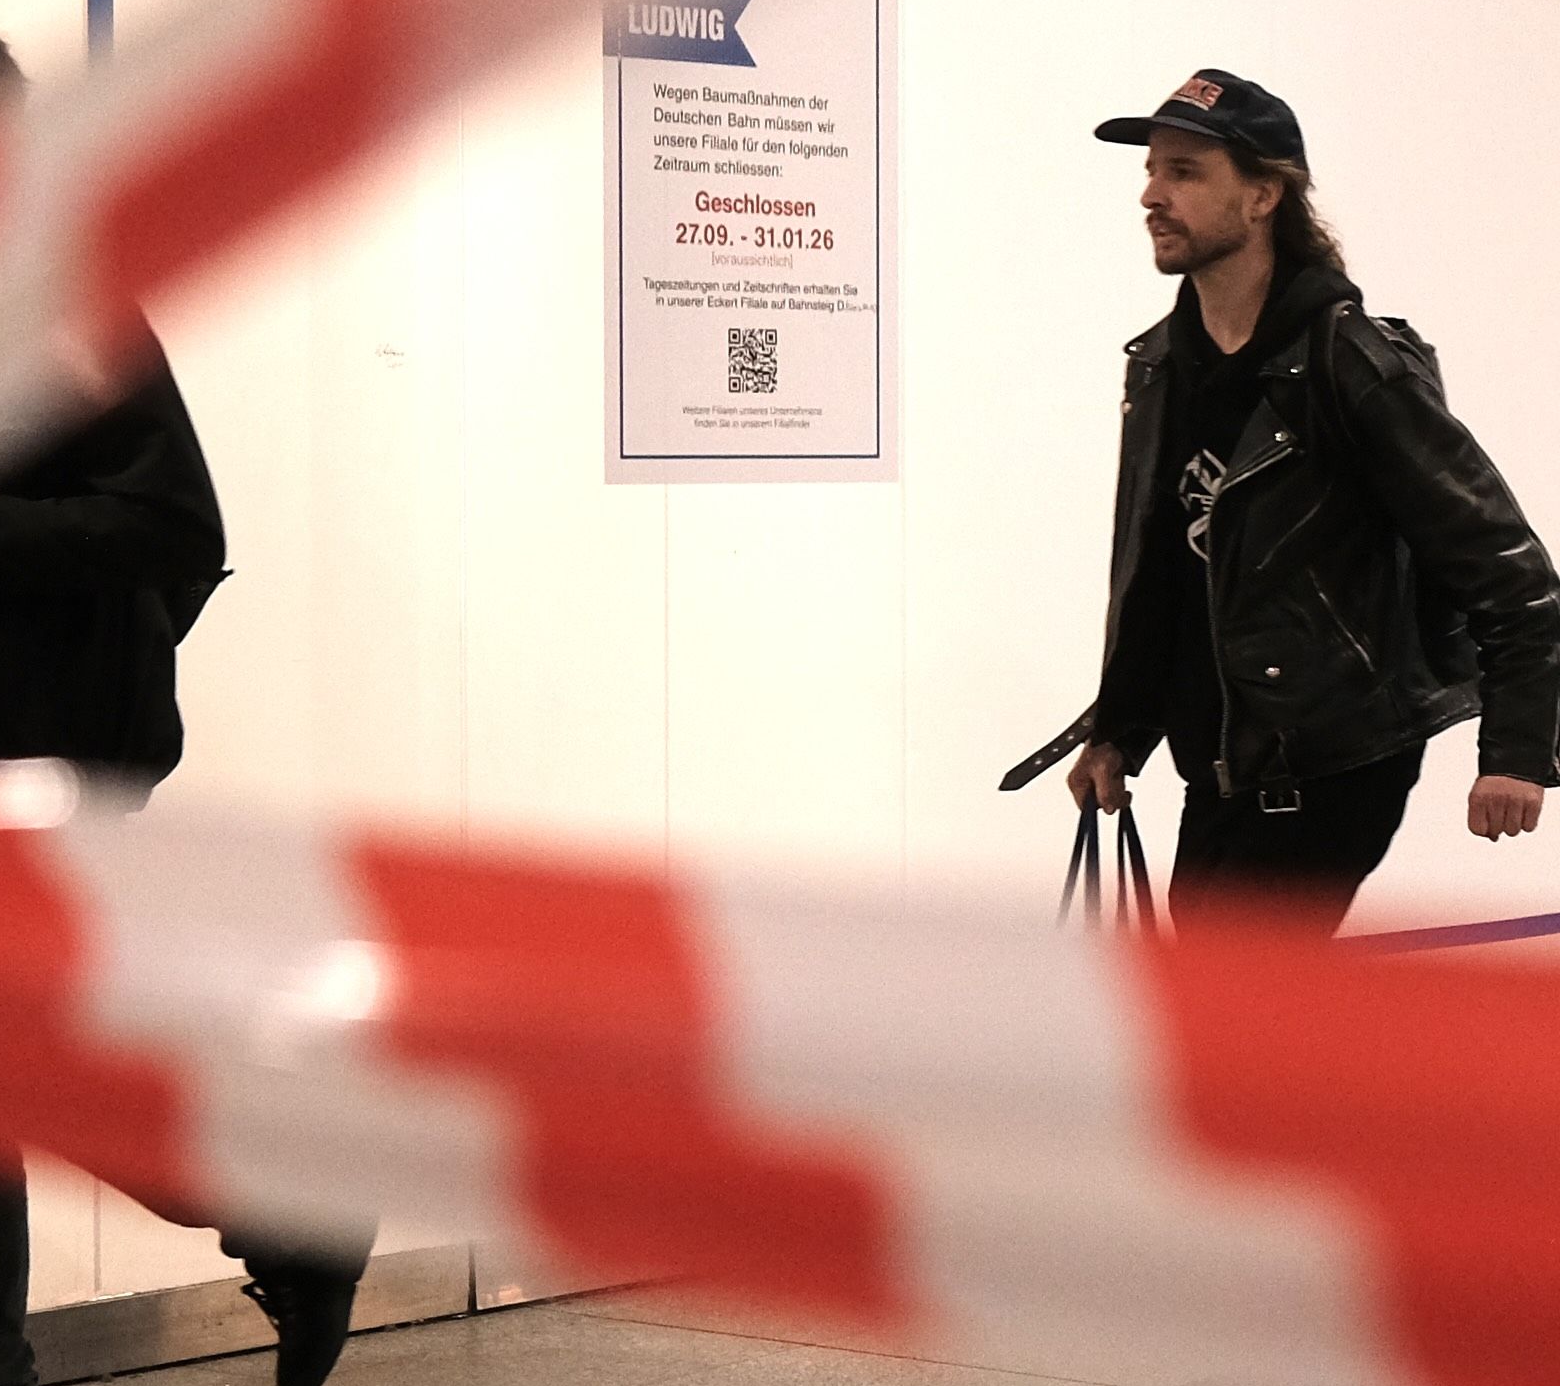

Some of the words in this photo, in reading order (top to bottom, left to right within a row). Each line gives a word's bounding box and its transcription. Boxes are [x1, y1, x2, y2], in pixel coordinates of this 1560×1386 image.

[628, 4, 725, 41] LUDWIG
[653, 83, 698, 103] Wegen
[702, 87, 805, 109] Baumaßnahmen
[809, 95, 829, 111] der
[654, 107, 722, 126] Deutschen
[728, 112, 760, 129] Bahn
[765, 117, 812, 133] müssen
[818, 119, 835, 134] wir
[653, 134, 697, 149] unsere
[702, 134, 738, 151] Filiale
[742, 137, 759, 152] für
[762, 139, 785, 155] den
[789, 140, 849, 159] folgenden
[653, 155, 710, 173] Zeitraum
[714, 160, 783, 178] schliessen:
[695, 190, 816, 217] Geschlossen
[676, 222, 734, 247] 27.09.
[754, 226, 834, 250] 31.01.26
[643, 277, 719, 294] Tageszeitungen
[722, 280, 740, 293] und
[708, 296, 738, 309] Eckert
